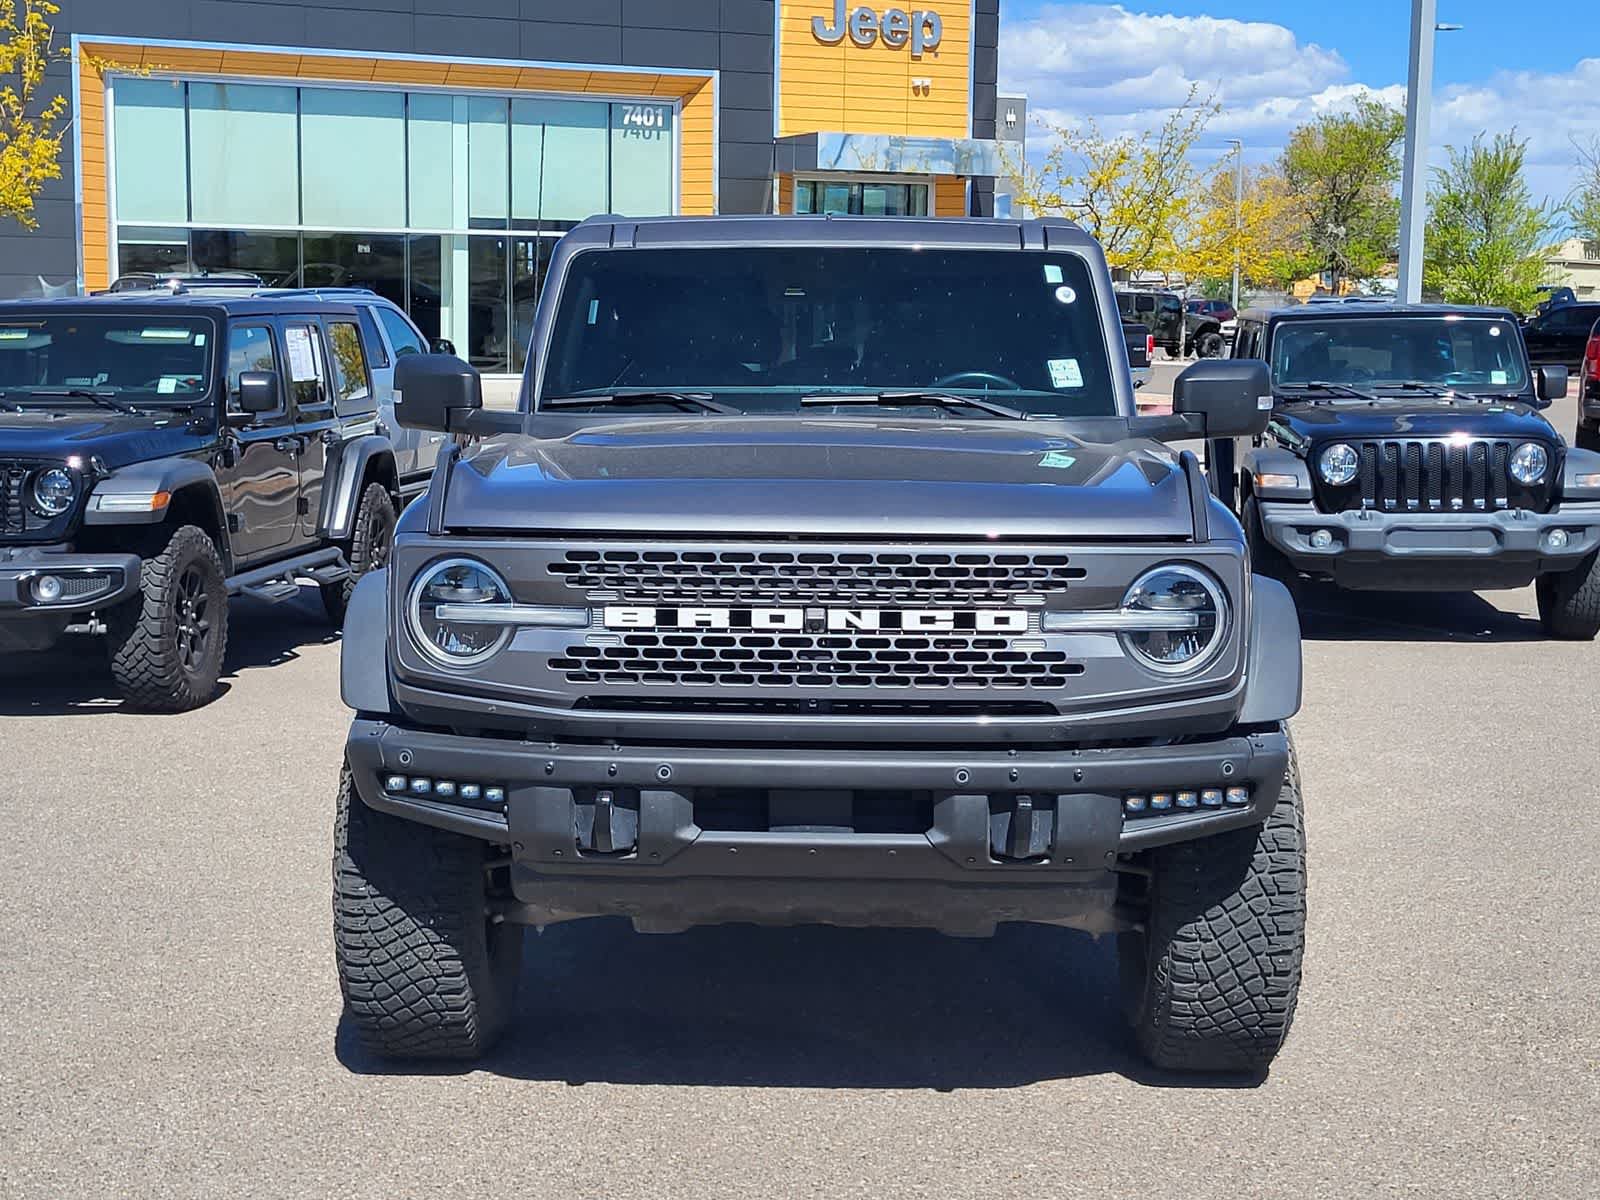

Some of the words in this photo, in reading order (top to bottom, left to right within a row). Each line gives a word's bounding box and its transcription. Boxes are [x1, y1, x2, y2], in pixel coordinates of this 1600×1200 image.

[811, 0, 943, 61] Jeep
[622, 105, 663, 128] 7401
[603, 605, 1028, 632] BRONCO
